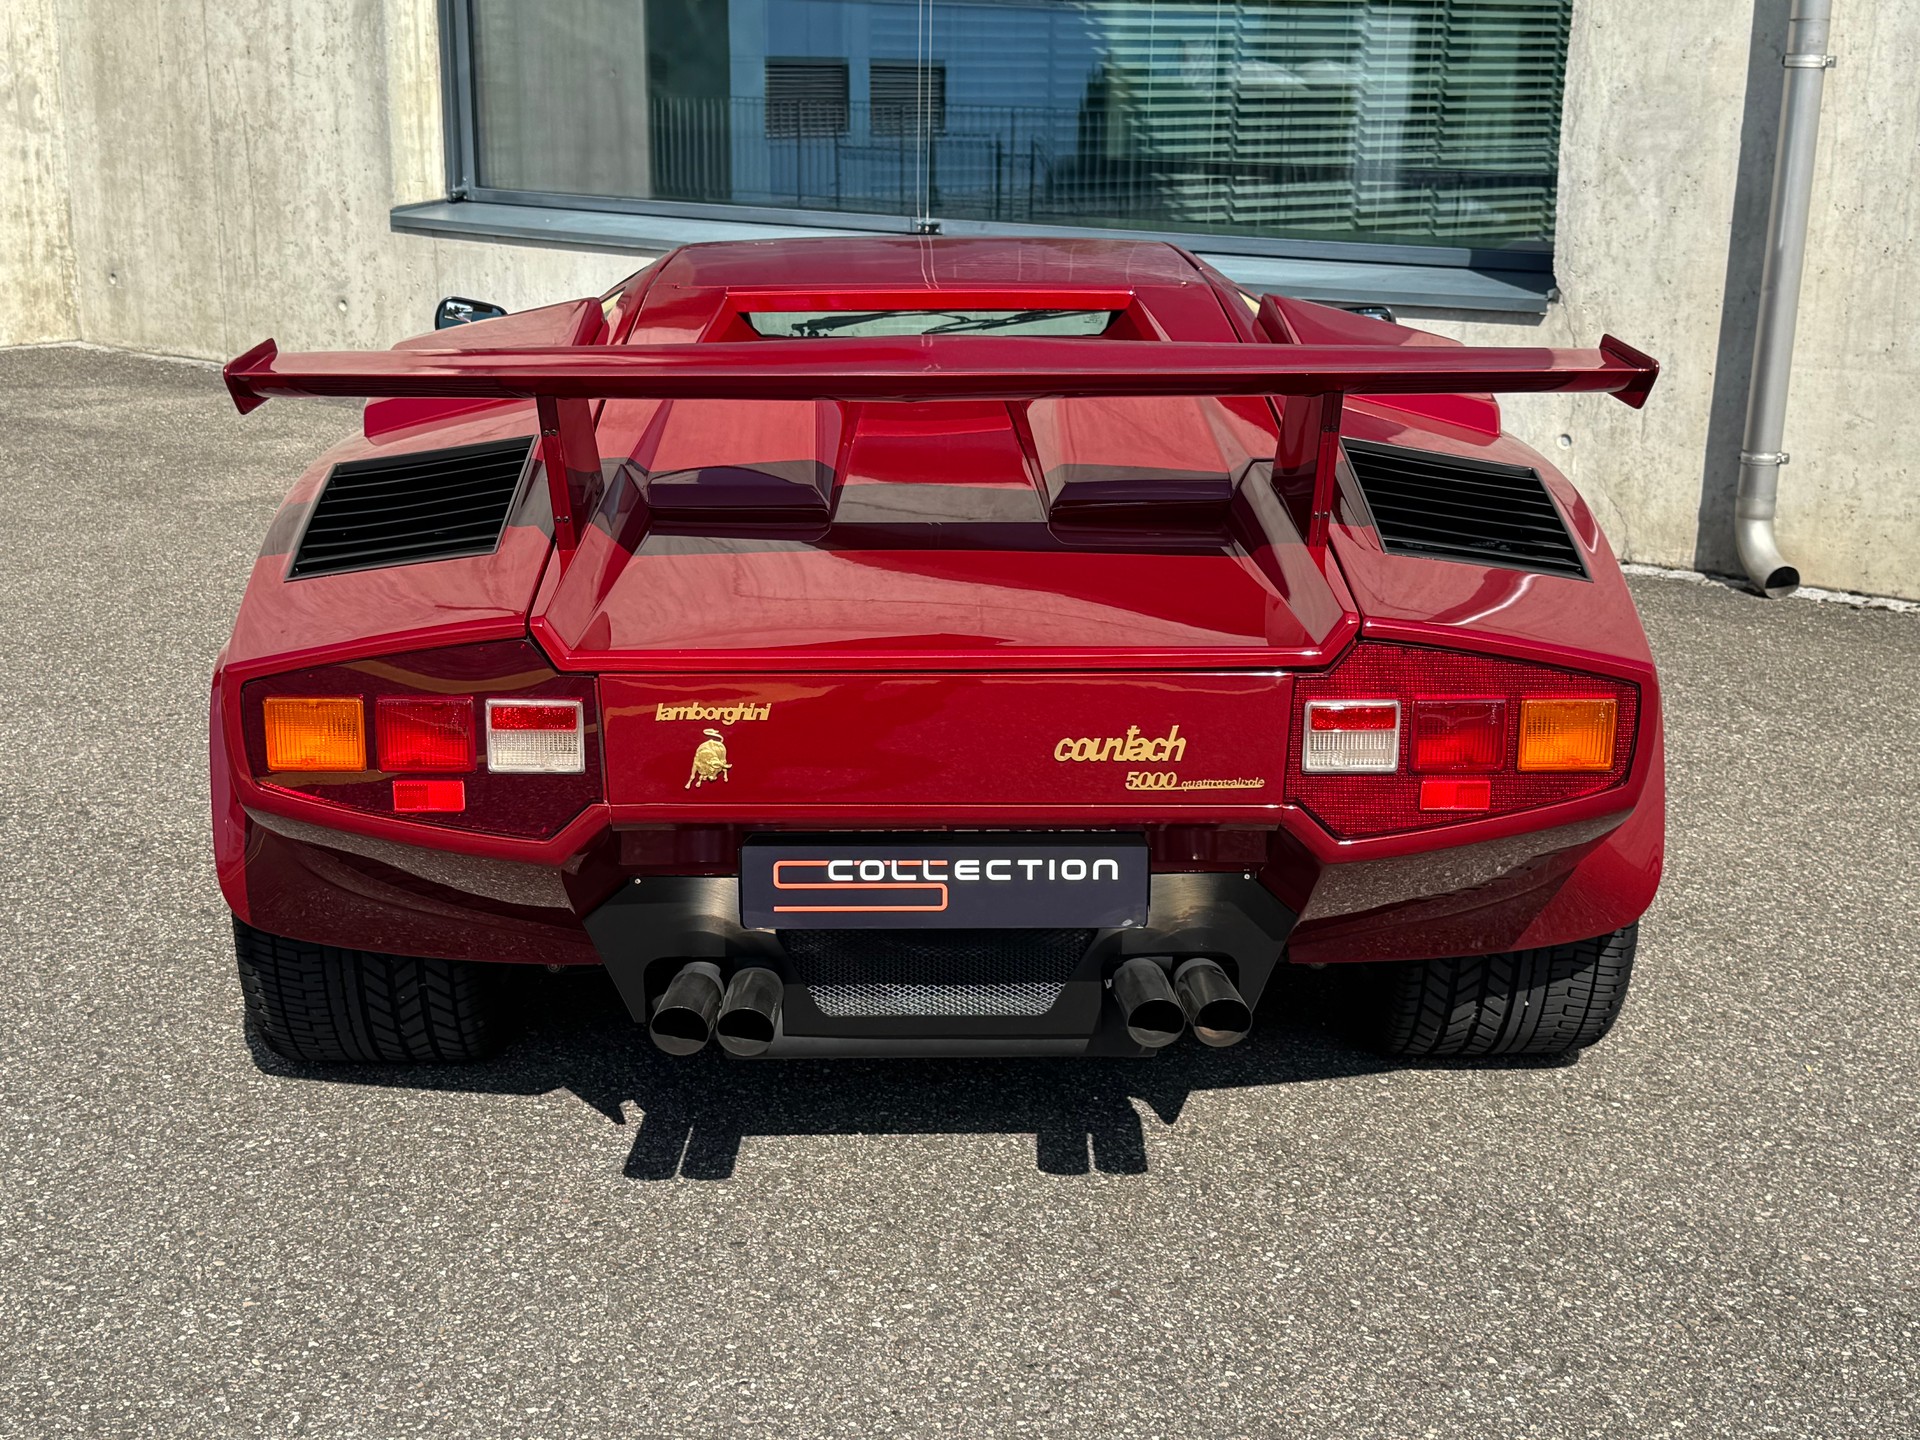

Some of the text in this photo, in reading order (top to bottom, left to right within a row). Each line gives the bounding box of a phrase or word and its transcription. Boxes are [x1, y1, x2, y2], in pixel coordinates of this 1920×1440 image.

[655, 702, 772, 726] lamborghini
[1054, 724, 1187, 762] countach
[1125, 772, 1178, 790] 5000
[828, 859, 1119, 881] COLLECTION
